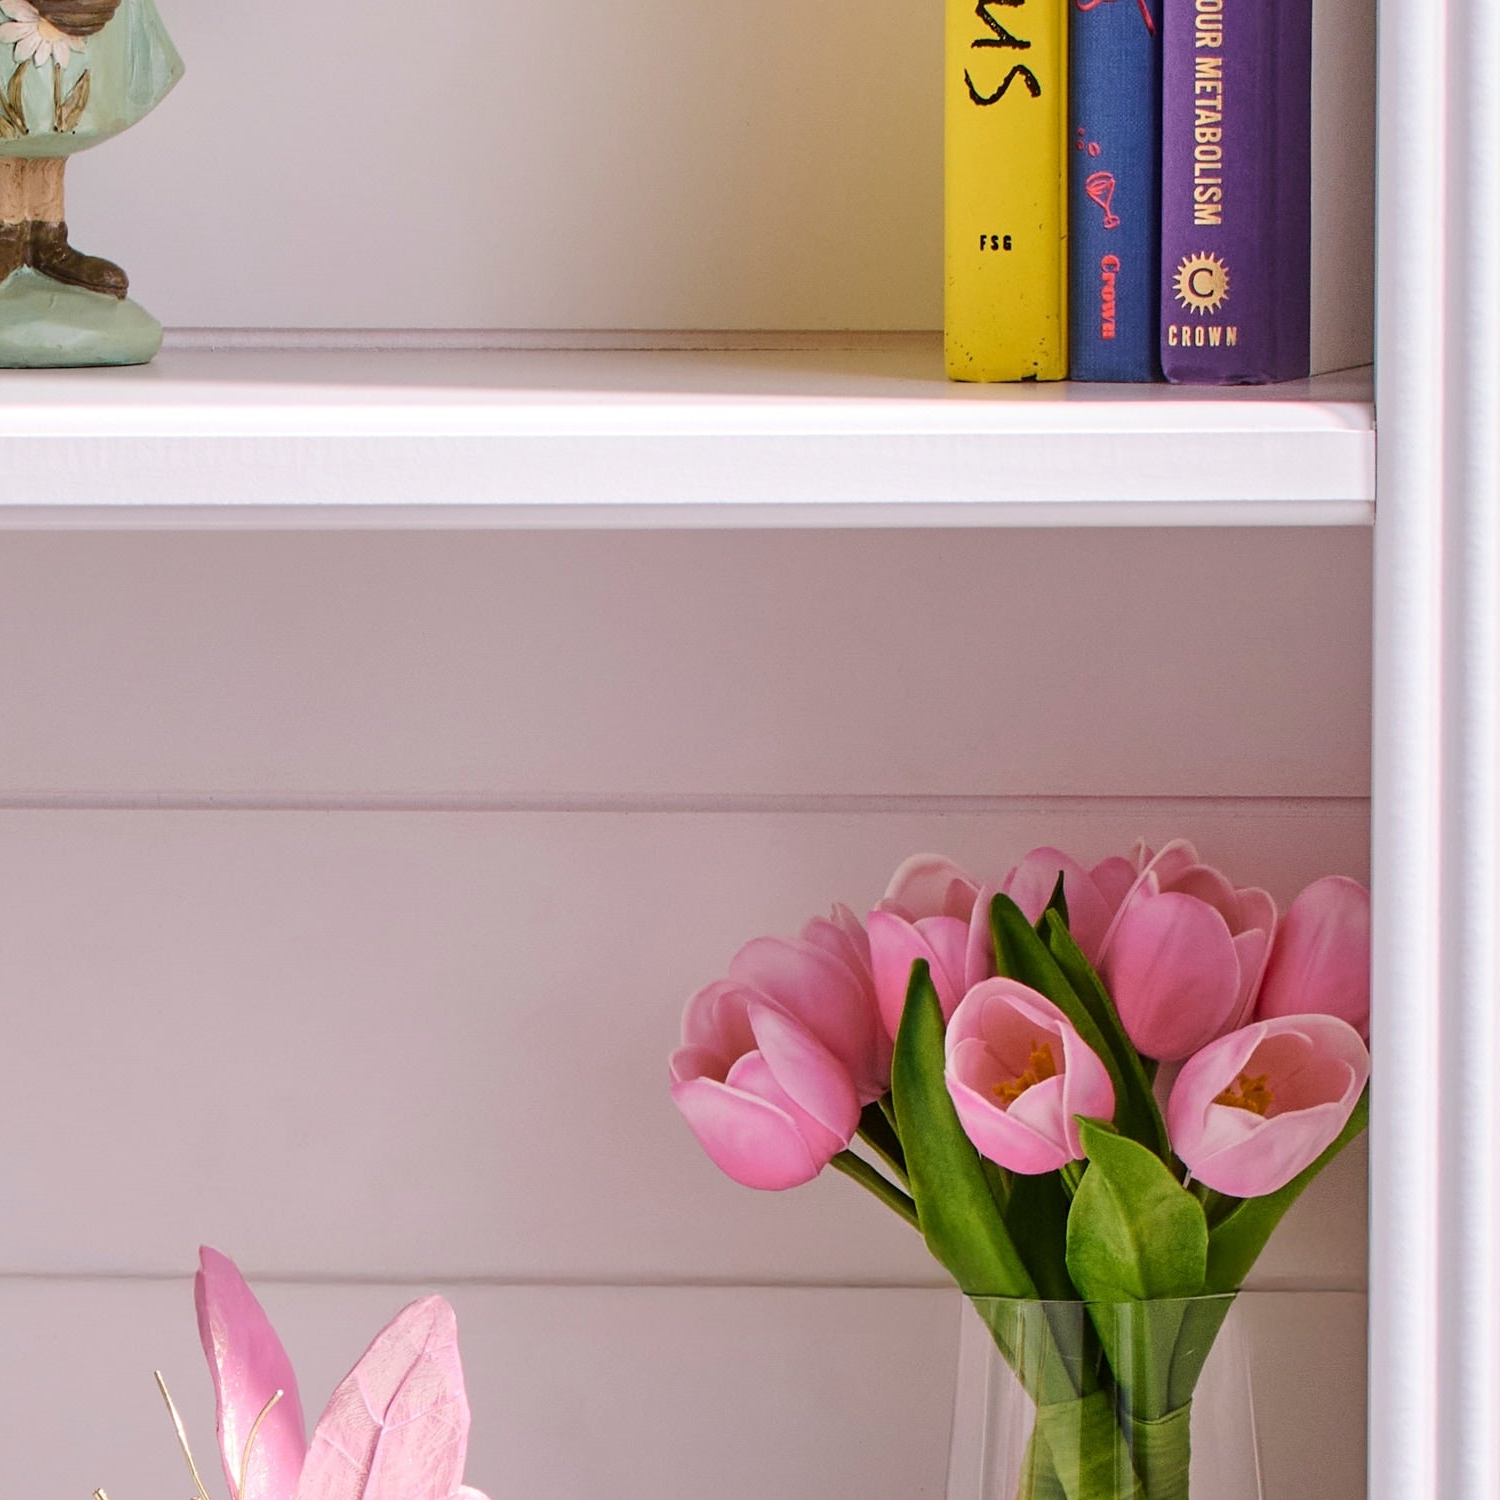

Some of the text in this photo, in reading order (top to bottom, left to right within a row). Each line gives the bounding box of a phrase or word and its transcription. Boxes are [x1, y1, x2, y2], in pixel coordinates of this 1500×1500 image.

[1193, 0, 1223, 225] OUR METABOLISM
[979, 234, 1012, 251] FSG
[1101, 254, 1122, 337] Crown
[1168, 324, 1237, 347] CROWN
